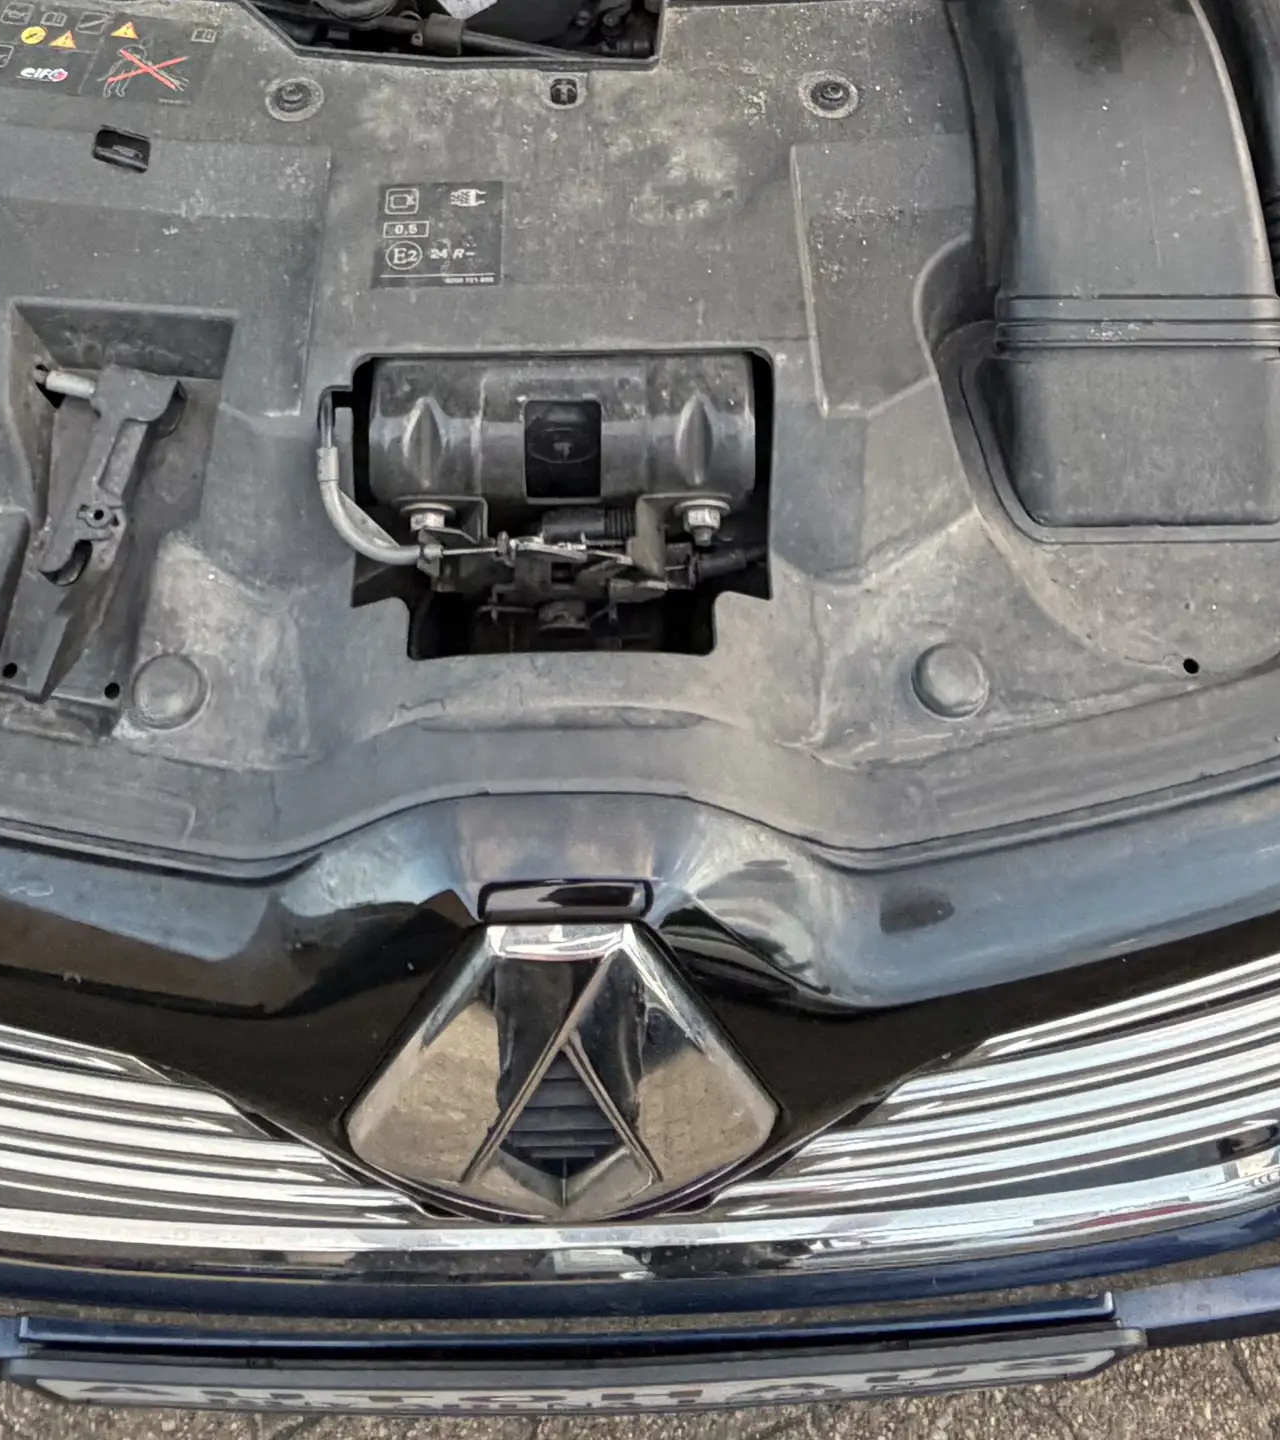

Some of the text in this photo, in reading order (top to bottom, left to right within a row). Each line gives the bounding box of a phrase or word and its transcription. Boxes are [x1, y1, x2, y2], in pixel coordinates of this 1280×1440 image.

[393, 248, 419, 264] E2
[428, 248, 448, 260] 24
[77, 1357, 1087, 1402] AUTOHAUS
